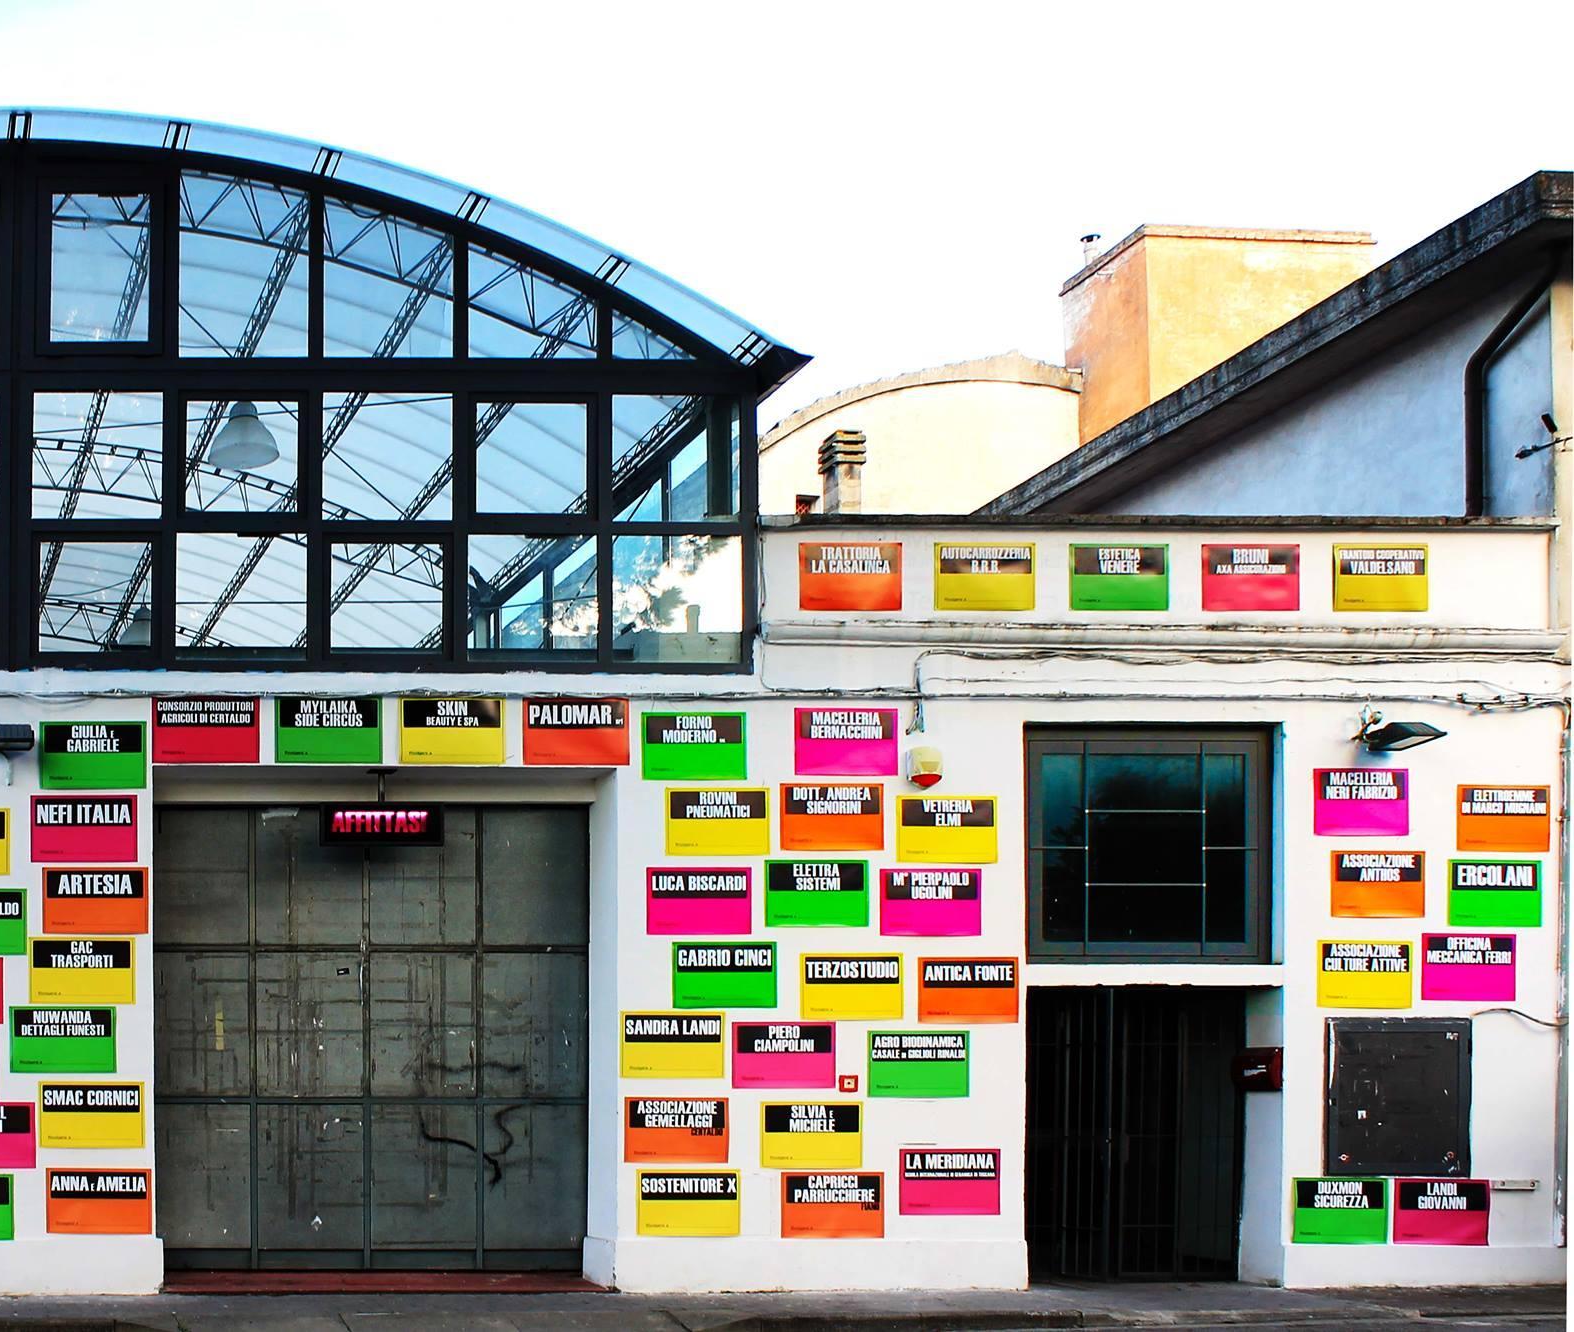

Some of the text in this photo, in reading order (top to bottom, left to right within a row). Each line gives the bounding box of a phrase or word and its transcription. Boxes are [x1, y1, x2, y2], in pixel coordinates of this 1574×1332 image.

[821, 547, 881, 560] TRATTORIA
[1099, 549, 1140, 560] ESTETICA
[812, 559, 889, 573] LA CASALINGA
[1100, 560, 1139, 573] VENERE
[157, 702, 254, 711] CONSORZIO PRODUTTORI
[437, 701, 468, 716] SKIN
[161, 713, 250, 723] AGRICOLI DI CERTALDO
[426, 716, 479, 726] BEAUTY E SPA
[530, 705, 612, 724] PALOMAR
[1330, 772, 1393, 786] MACELLERIA
[793, 787, 871, 800] DOTT. ANDREA
[1326, 786, 1397, 799] NERI FABRIZIO
[37, 804, 131, 823] NEFI ITALIA
[807, 800, 861, 814] SIGNORINI
[332, 811, 428, 833] AFFITTASI
[1458, 865, 1533, 886] ERCOLANI
[71, 941, 93, 954] GAC
[1447, 937, 1491, 950] OFFICINA
[678, 949, 771, 966] GABRIO CINCI
[1330, 944, 1401, 958] ASSOCIAZIONE
[1427, 950, 1511, 964] MECCANICA FERRI
[51, 954, 113, 968] TRASPORTI
[1325, 957, 1407, 971] CULTURE ATTIVE
[874, 1036, 964, 1048] AGRO BIODINAMICA
[872, 1049, 900, 1059] CASALE
[637, 1101, 717, 1114] ASSOCIAZIONE
[645, 1114, 712, 1128] GEMELLAGGI
[906, 1154, 994, 1169] LA MERIDIANA
[51, 1176, 146, 1192] ANNA E AMELIA
[808, 1175, 858, 1189] CAPRICCI
[1318, 1181, 1362, 1194] DUXMON
[1427, 1182, 1457, 1196] LANDI
[794, 1189, 875, 1202] PARRUCCHIERE
[1314, 1195, 1369, 1208] SICUREZZA
[1418, 1196, 1466, 1209] GIOVANNI
